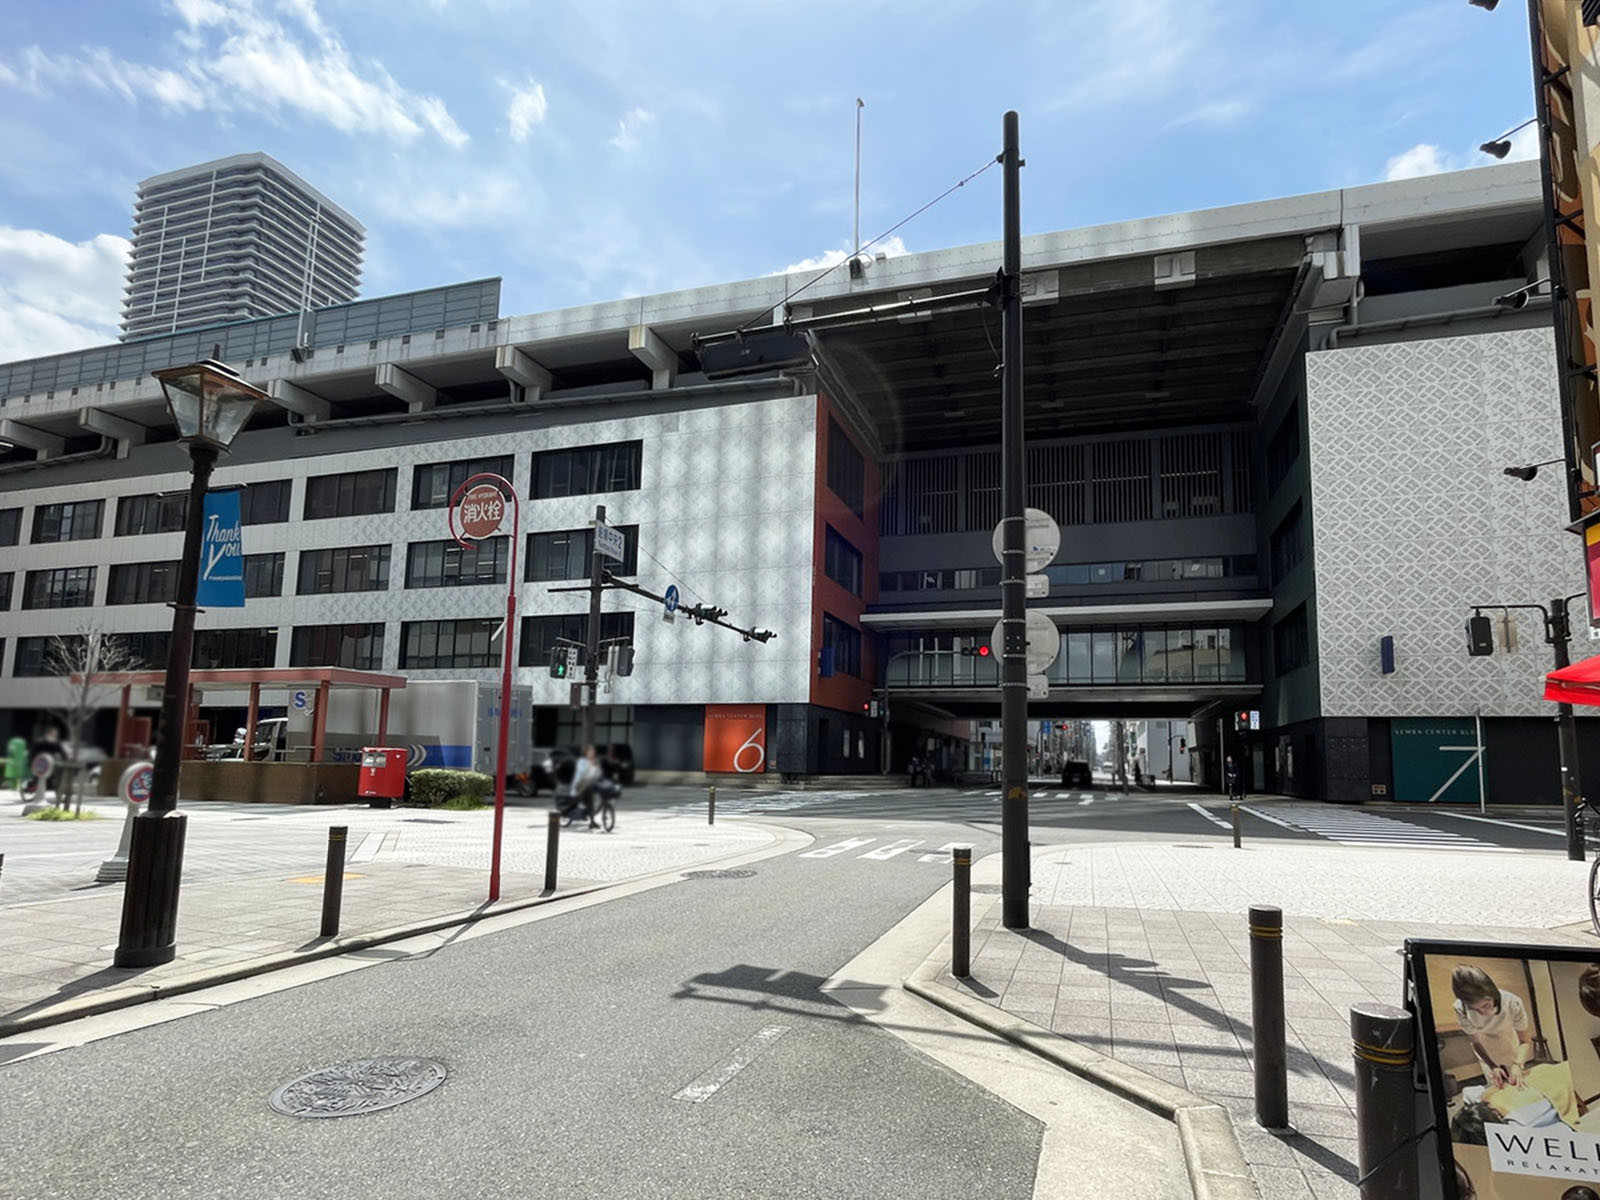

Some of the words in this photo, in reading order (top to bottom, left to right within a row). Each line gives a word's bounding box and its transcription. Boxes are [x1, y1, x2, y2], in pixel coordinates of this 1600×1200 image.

[206, 514, 241, 542] Thank
[463, 500, 502, 524] 消火栓
[203, 543, 241, 581] You
[733, 728, 765, 773] 6
[1428, 745, 1487, 802] 7
